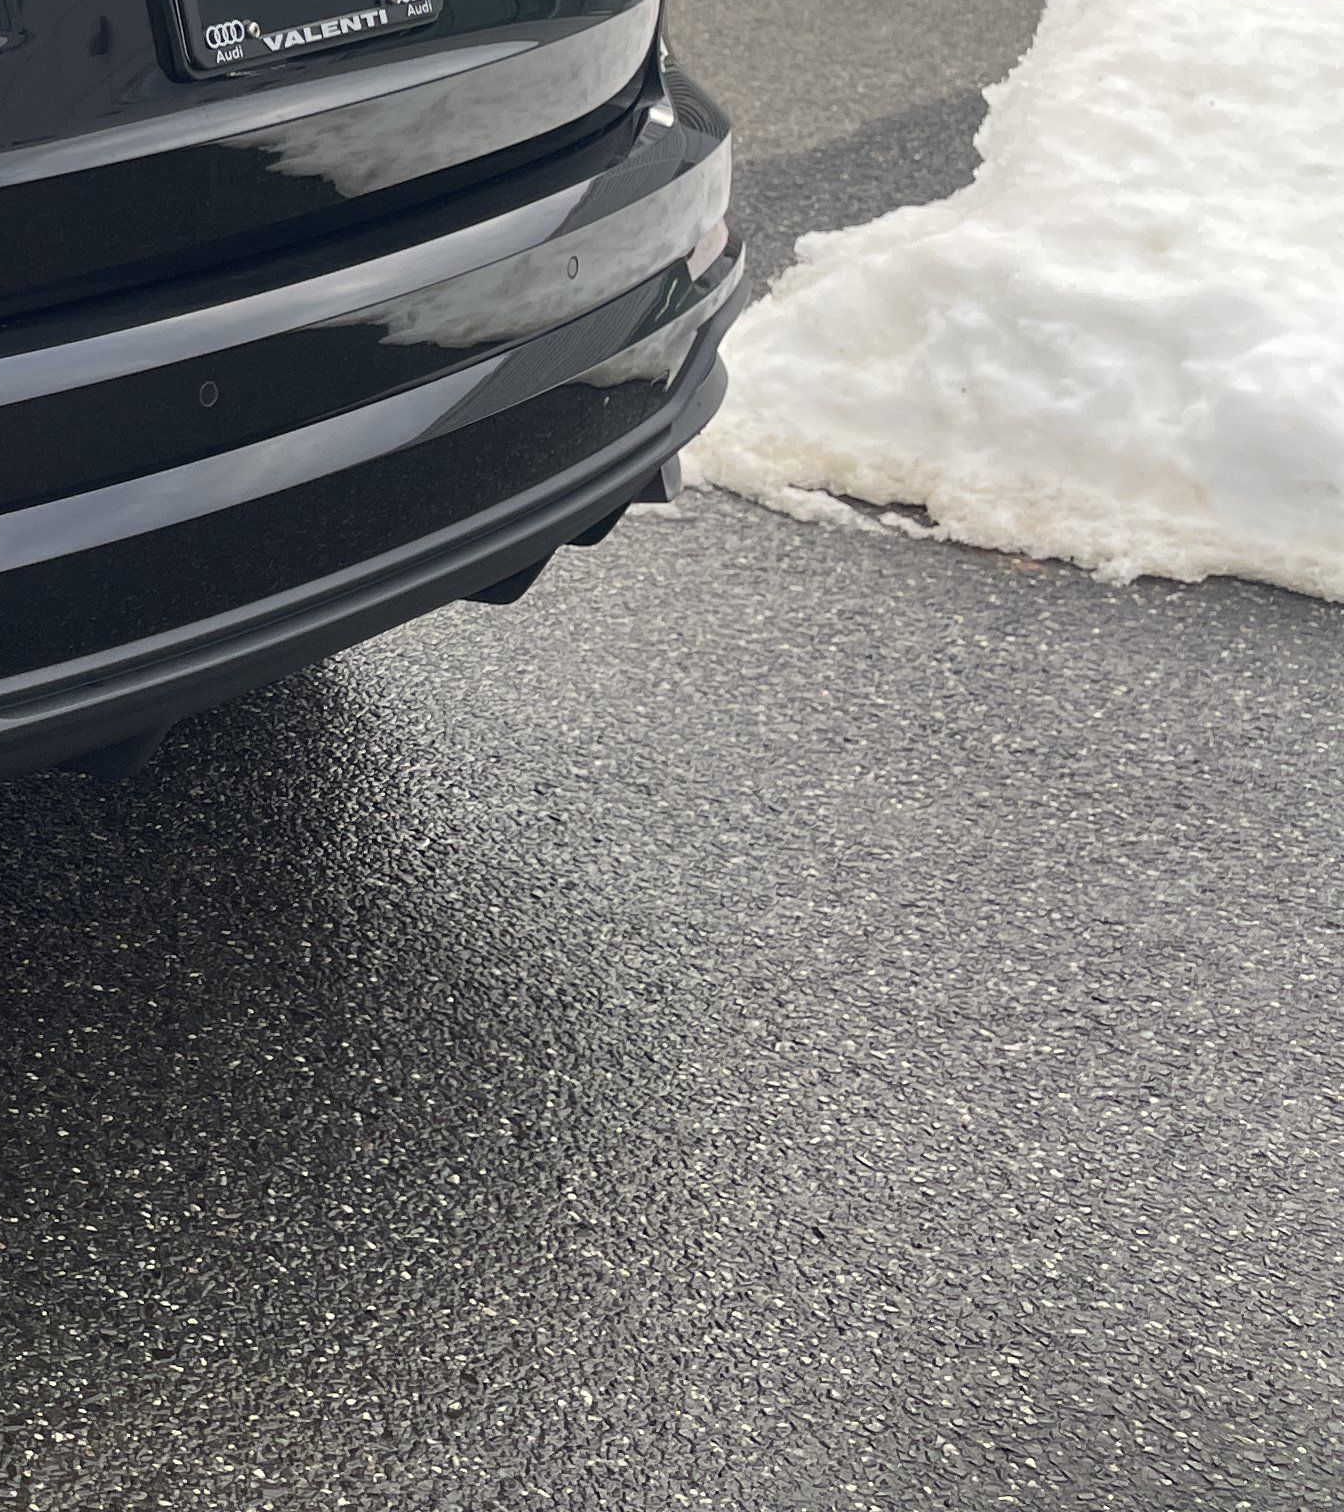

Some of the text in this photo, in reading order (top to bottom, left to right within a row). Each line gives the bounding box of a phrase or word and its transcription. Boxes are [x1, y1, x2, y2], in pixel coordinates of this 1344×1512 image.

[407, 0, 433, 17] Audi
[263, 9, 388, 52] VALENTI
[216, 45, 244, 64] Audi
